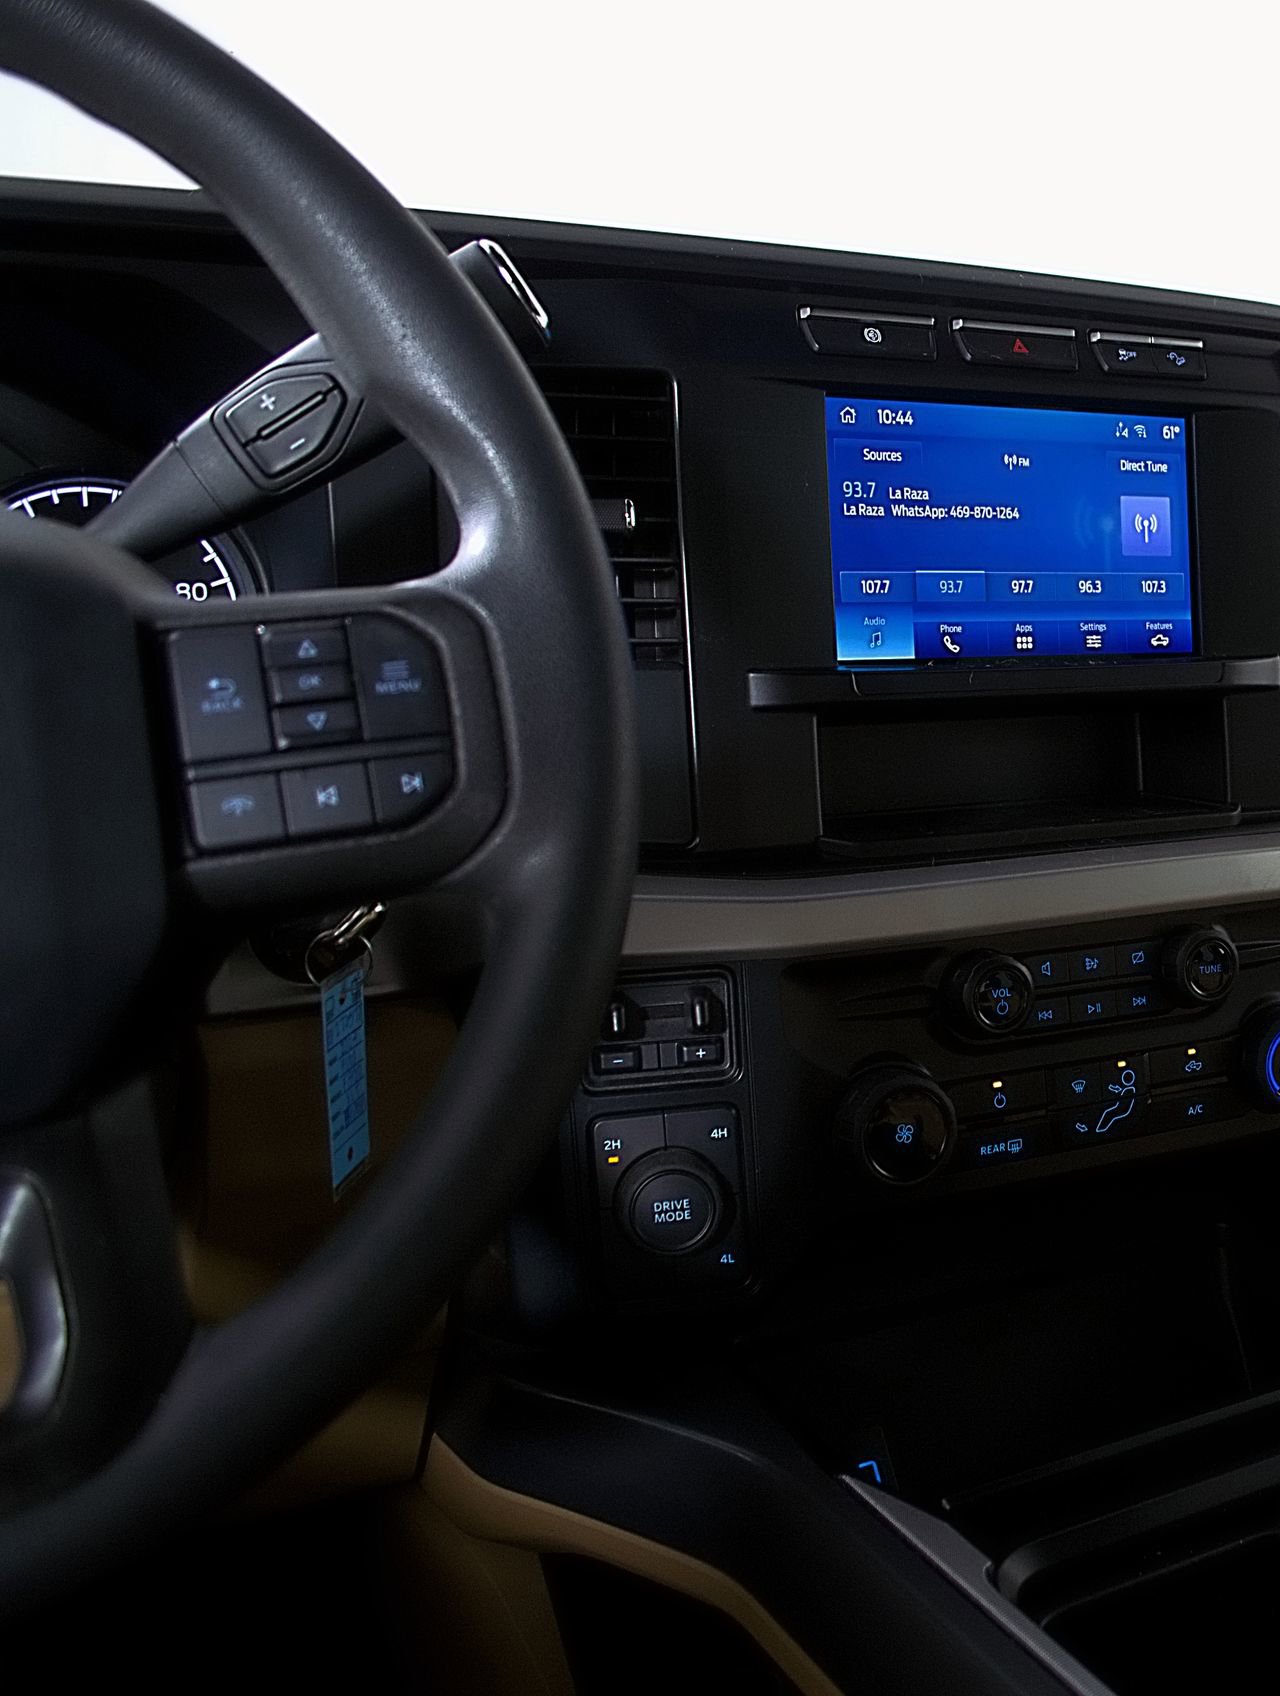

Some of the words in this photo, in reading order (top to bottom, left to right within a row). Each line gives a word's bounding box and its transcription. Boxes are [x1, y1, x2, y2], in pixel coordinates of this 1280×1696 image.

[877, 408, 914, 426] 10:44
[863, 447, 902, 462] Sources
[1018, 456, 1030, 467] FM
[1120, 459, 1144, 472] Direct
[1146, 460, 1168, 473] Tune
[843, 481, 876, 498] 93.7
[889, 487, 901, 500] La
[903, 487, 929, 501] Raza
[843, 504, 856, 516] La
[858, 504, 885, 517] Raza
[891, 504, 948, 520] WhatsApp:
[950, 506, 1019, 520] 469-870-1264
[175, 582, 208, 601] 80
[861, 579, 890, 594] 107.7
[939, 579, 963, 594] 93.7
[1011, 579, 1033, 594] 97.7
[1078, 579, 1102, 594] 96.3
[1141, 579, 1167, 594] 107.3
[864, 616, 886, 626] Audio
[1079, 622, 1106, 634] Settings
[1146, 621, 1173, 631] Features
[940, 624, 962, 634] Phone
[1015, 623, 1033, 634] Apps
[297, 673, 323, 691] OK
[375, 679, 422, 695] MENU
[1199, 963, 1223, 975] TUNE
[991, 988, 1012, 999] VOL
[1188, 1104, 1204, 1116] A/C
[710, 1127, 728, 1140] 4H
[603, 1139, 622, 1151] 2H
[980, 1142, 1006, 1156] REAR
[653, 1198, 691, 1213] DRIVE
[654, 1210, 692, 1224] MODE
[720, 1253, 735, 1265] 4L
